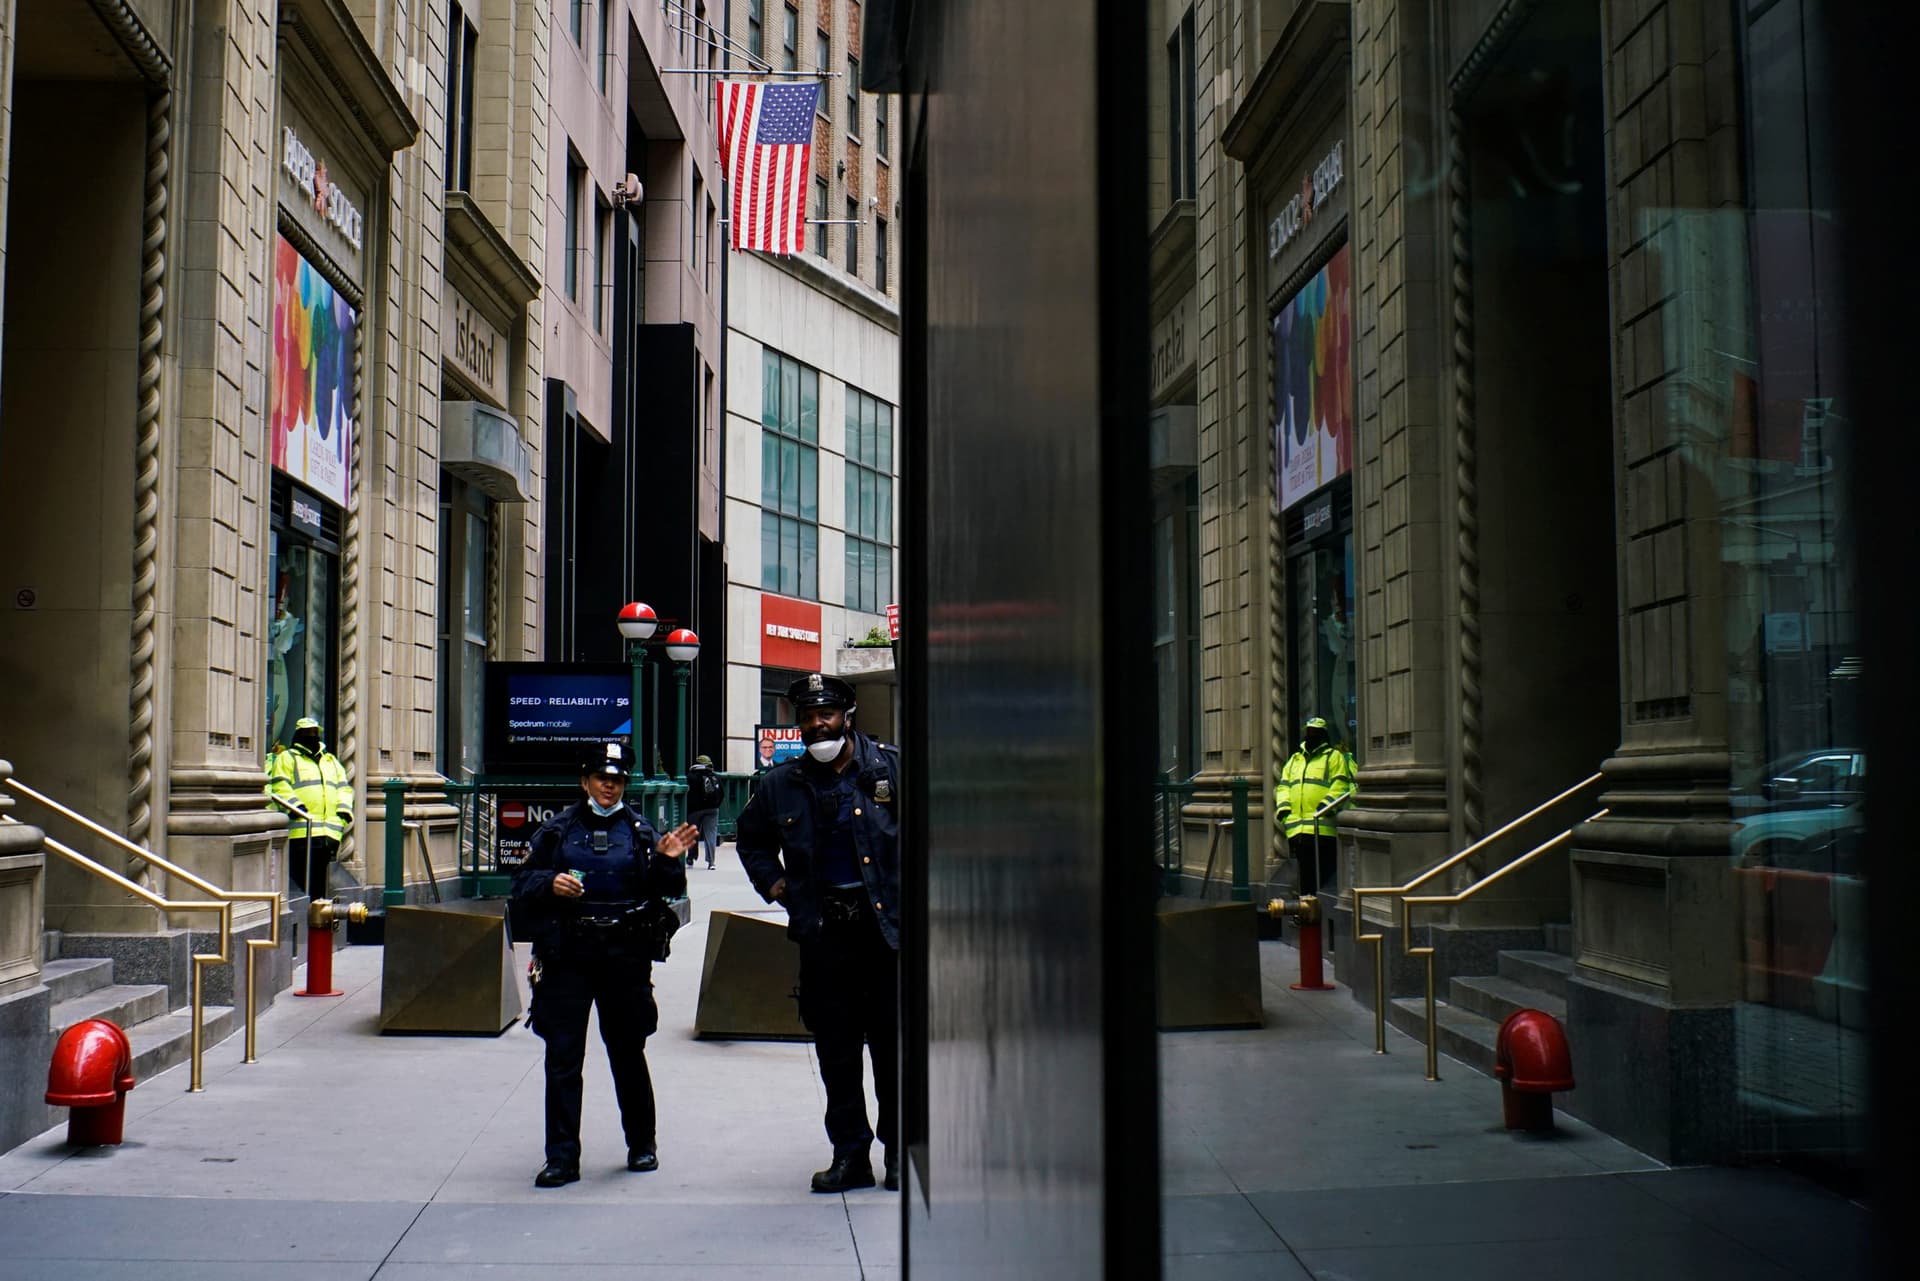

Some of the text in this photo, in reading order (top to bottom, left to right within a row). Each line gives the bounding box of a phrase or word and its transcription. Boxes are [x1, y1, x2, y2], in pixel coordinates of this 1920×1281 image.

[283, 126, 316, 200] PAPER
[455, 297, 495, 389] island
[510, 697, 630, 707] SPEED RELIABILITY 5G
[509, 720, 571, 728] Spectrum mobile
[527, 805, 555, 823] No
[500, 839, 521, 848] Enter
[500, 848, 512, 856] for
